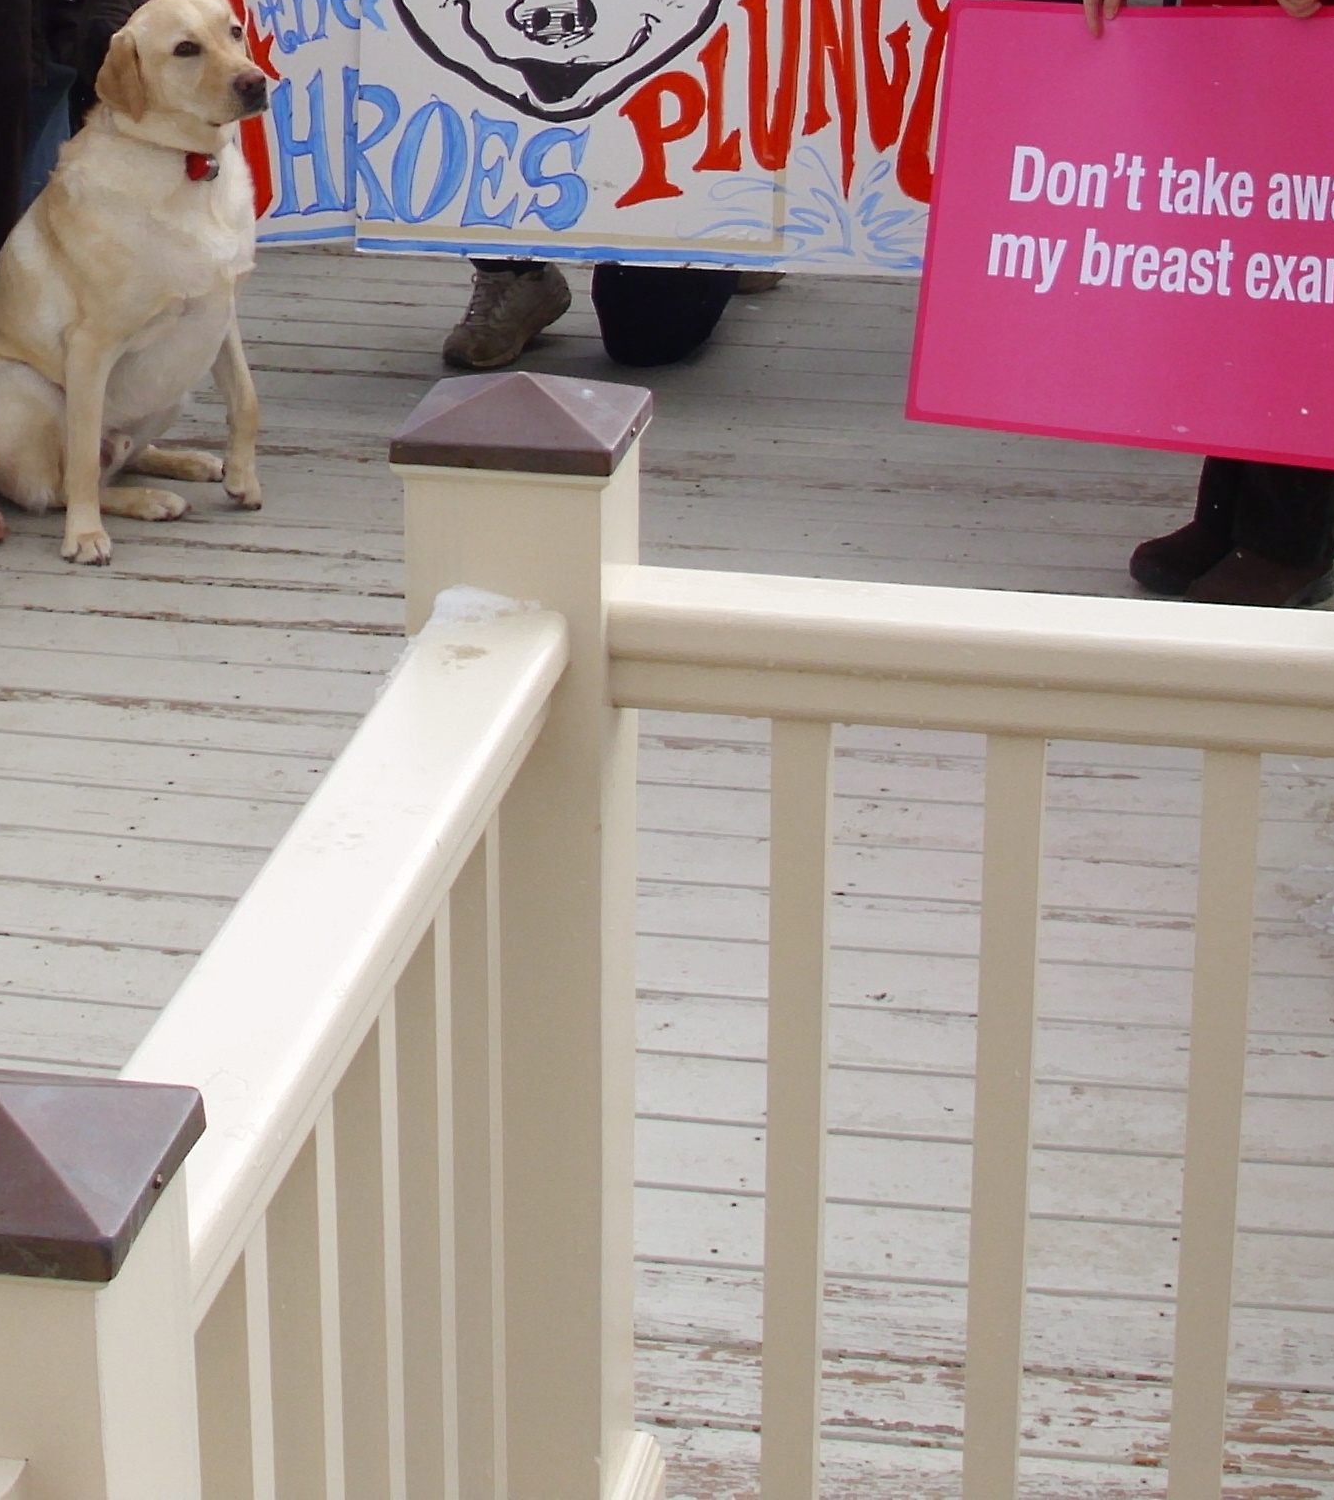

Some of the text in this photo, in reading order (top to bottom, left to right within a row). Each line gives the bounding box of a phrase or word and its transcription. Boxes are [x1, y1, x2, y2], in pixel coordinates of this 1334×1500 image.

[1008, 145, 1145, 211] Don't
[1158, 156, 1254, 218] take
[987, 233, 1068, 294] my
[1079, 228, 1234, 296] breast
